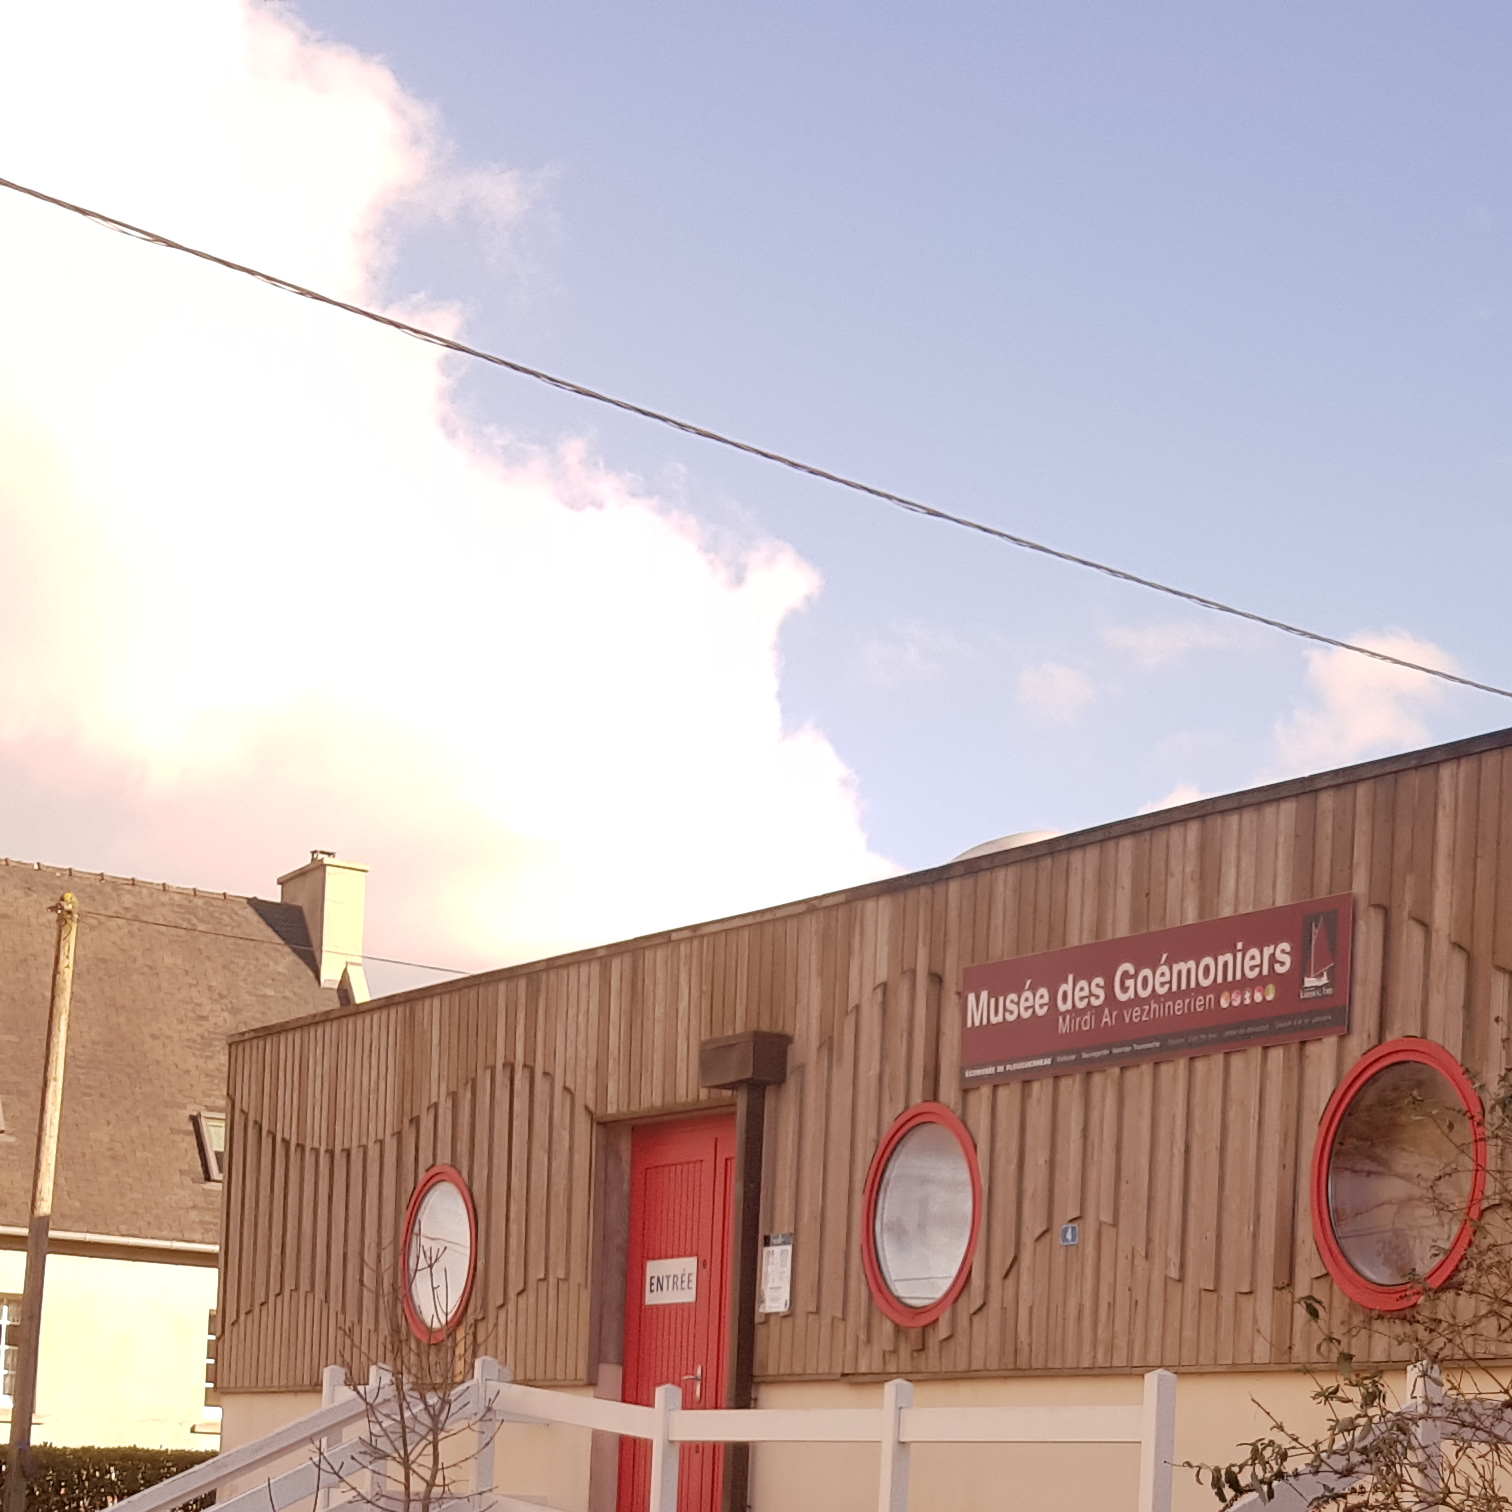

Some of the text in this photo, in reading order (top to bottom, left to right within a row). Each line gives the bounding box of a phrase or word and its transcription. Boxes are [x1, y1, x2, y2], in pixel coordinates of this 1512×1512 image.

[966, 942, 1292, 1029] Musée des Goémoniers
[1058, 993, 1215, 1034] Mirdi Ar vezhinerien
[649, 1268, 694, 1293] ENTRÉE
